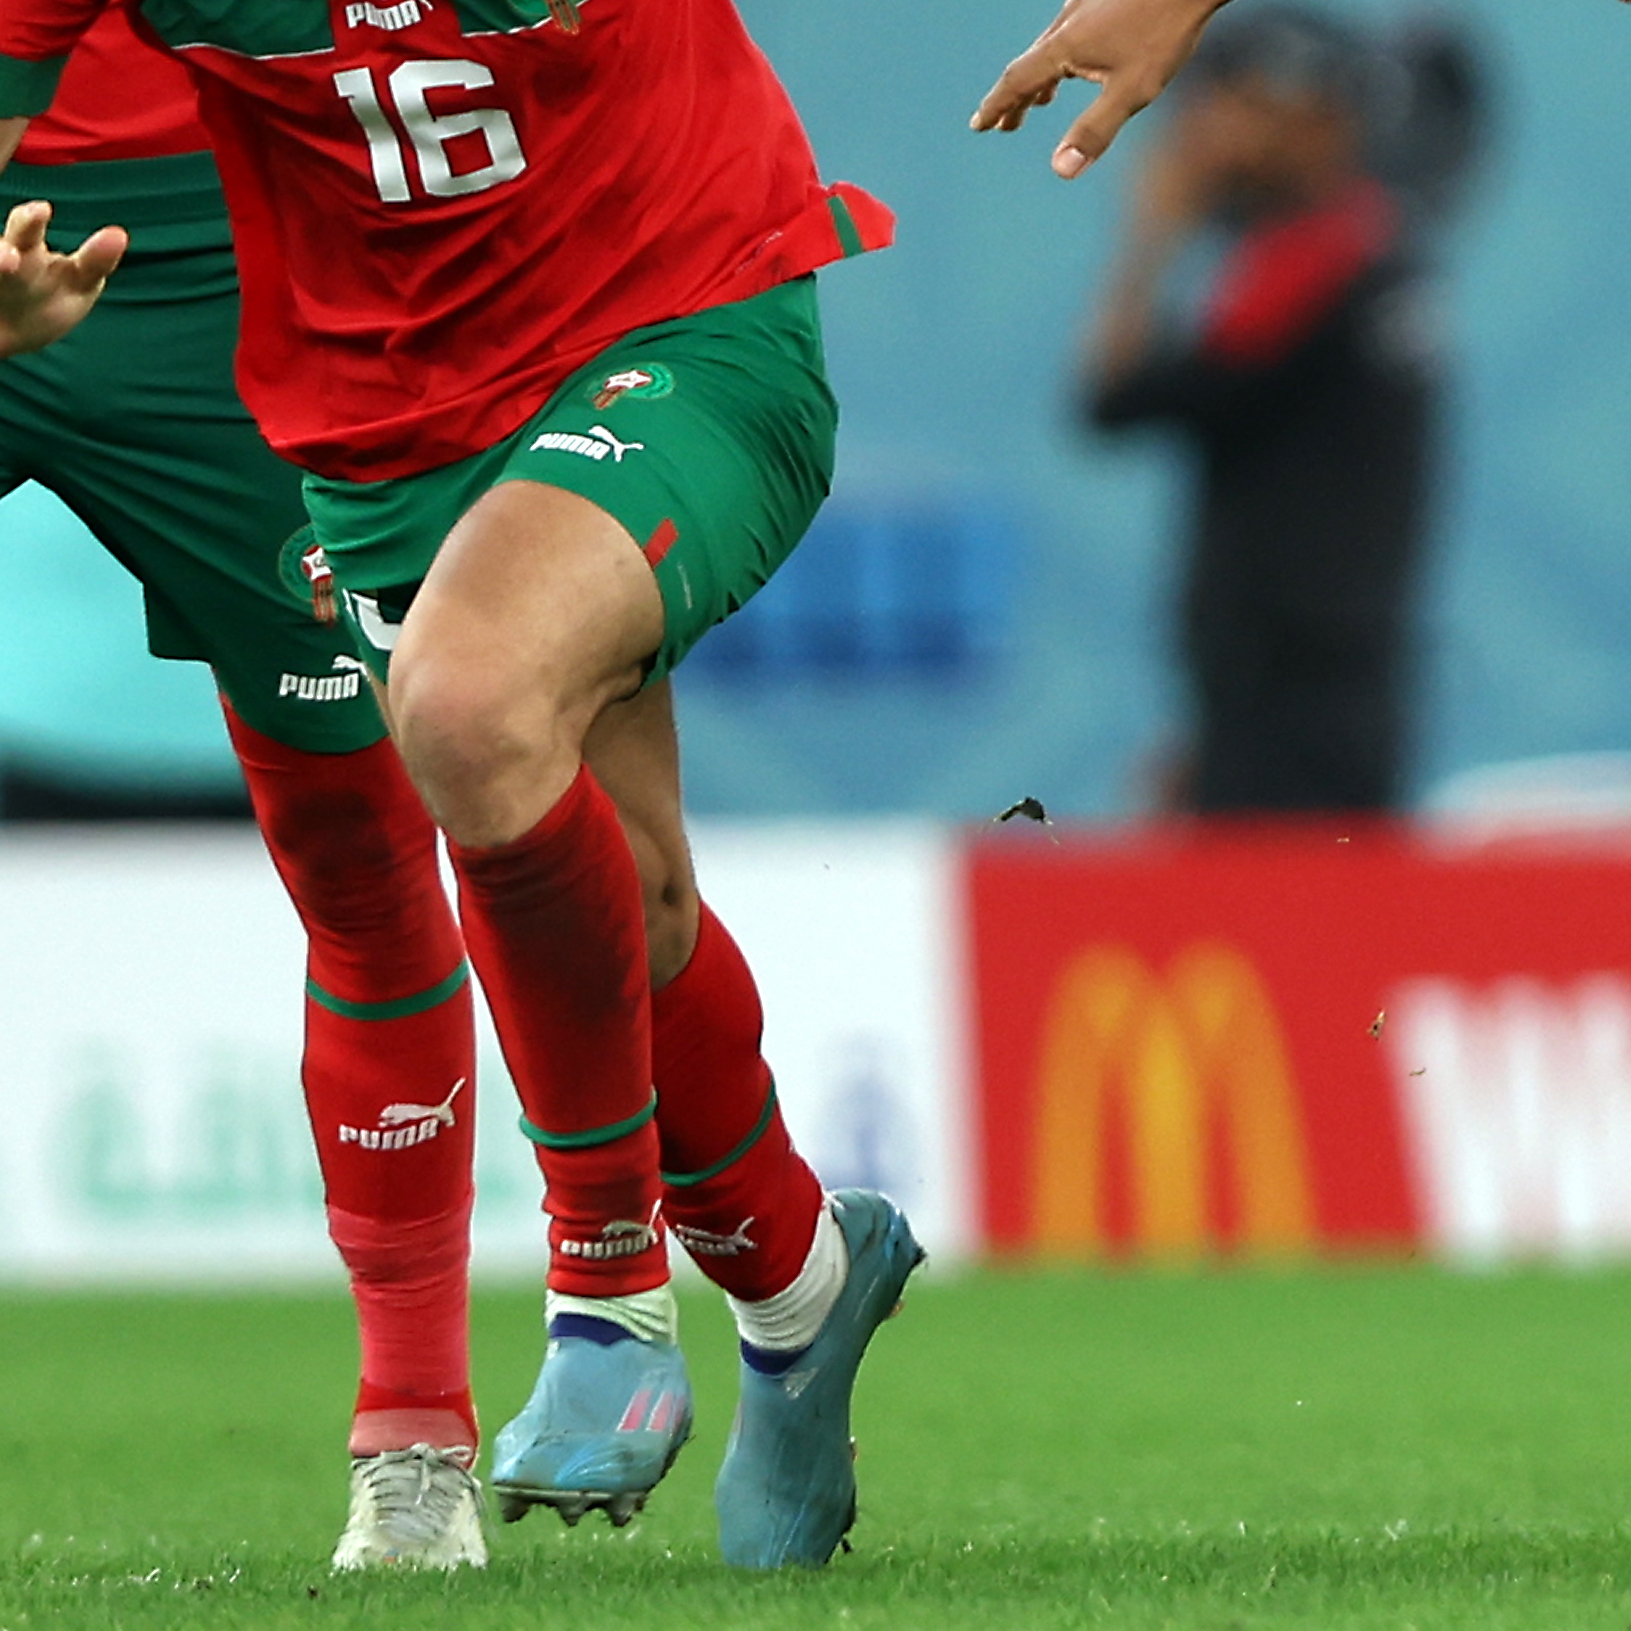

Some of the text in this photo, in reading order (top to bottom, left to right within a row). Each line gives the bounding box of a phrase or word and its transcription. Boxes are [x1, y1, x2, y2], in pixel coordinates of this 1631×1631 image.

[333, 59, 527, 204] 16
[529, 432, 611, 461] PUMA
[279, 671, 359, 701] PUMA
[338, 1118, 439, 1151] PUMA
